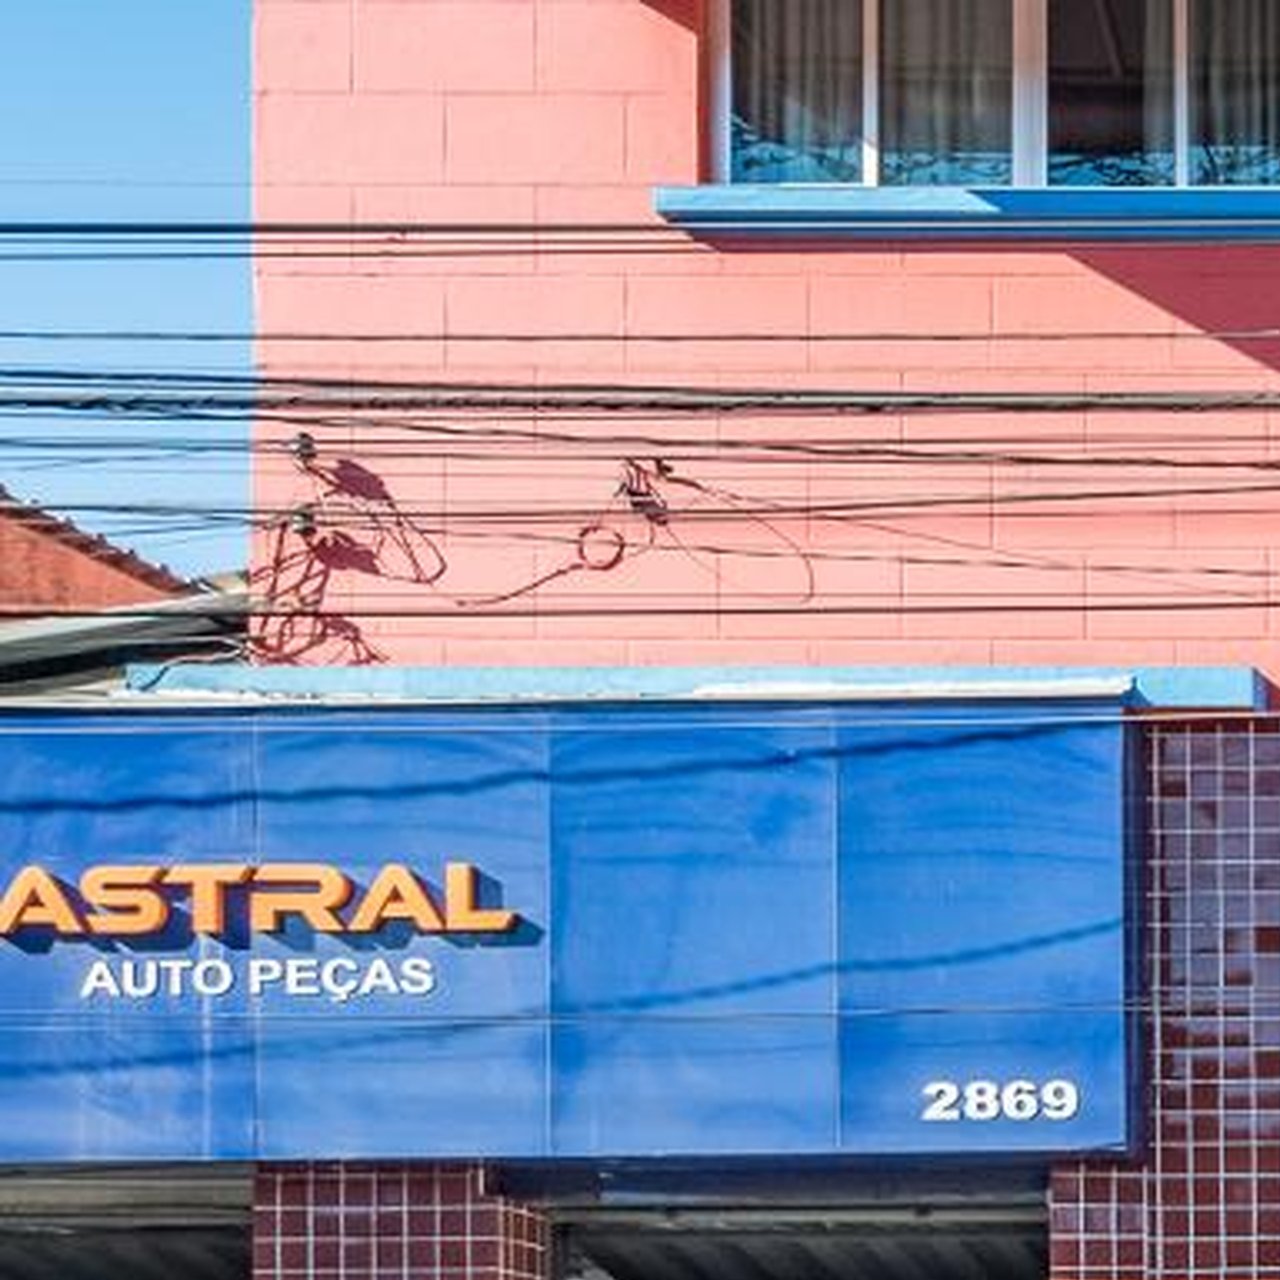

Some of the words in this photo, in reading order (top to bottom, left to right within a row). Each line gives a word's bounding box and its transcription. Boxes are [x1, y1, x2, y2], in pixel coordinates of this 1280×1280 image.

[0, 862, 518, 936] ASTRAL
[81, 958, 235, 998] AUTO
[249, 958, 436, 1003] PEÇAS
[920, 1080, 1081, 1122] 2869
